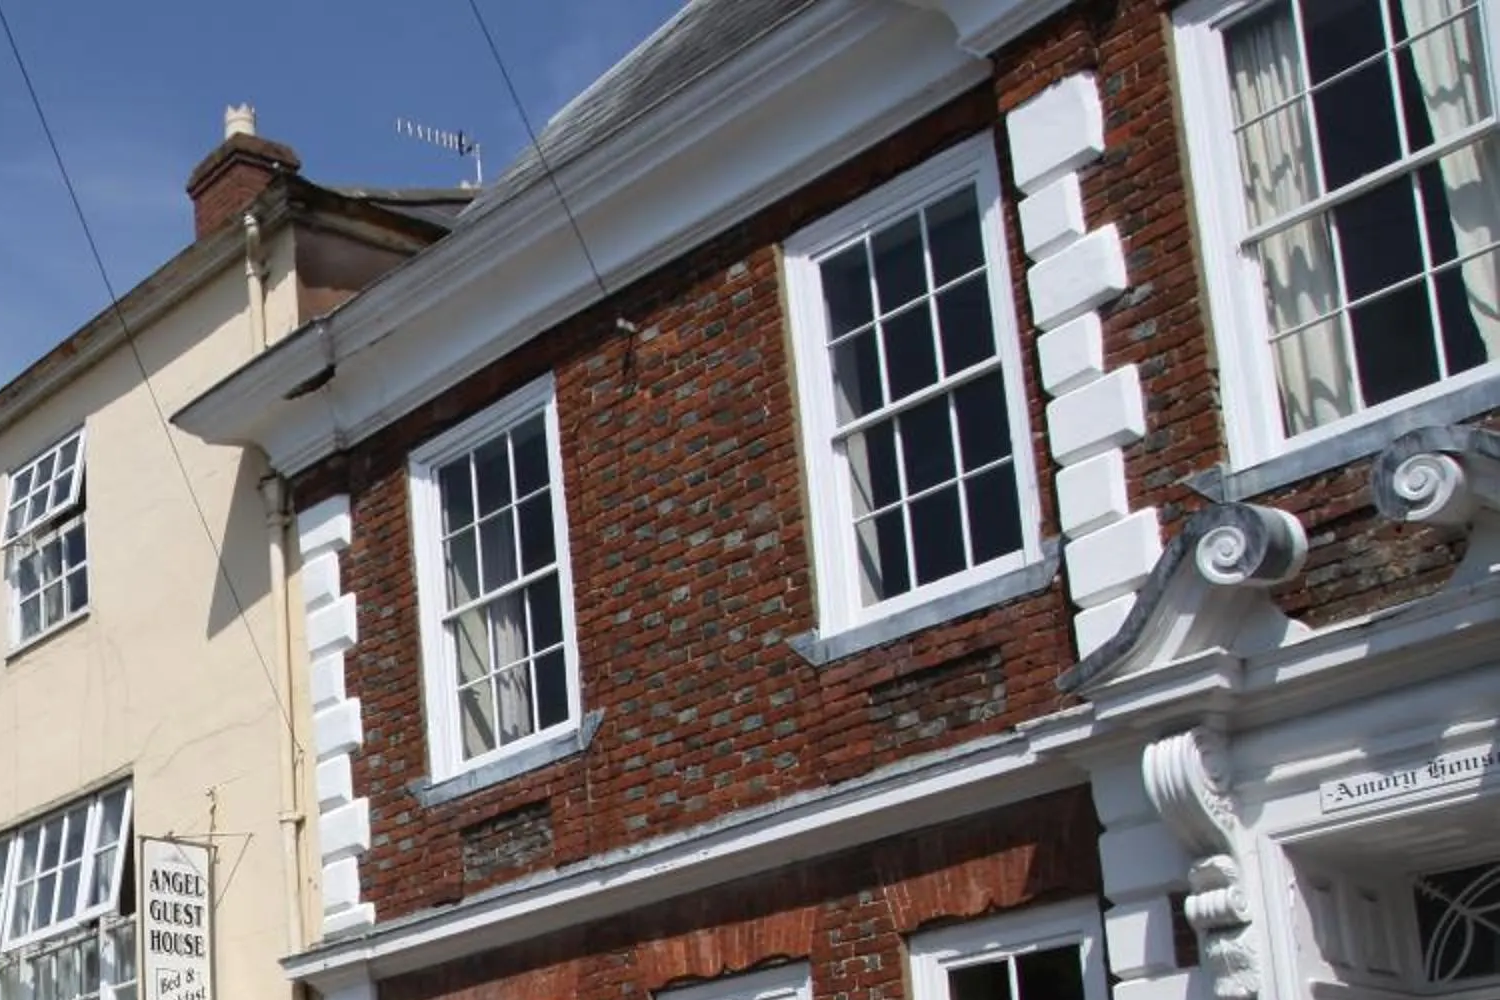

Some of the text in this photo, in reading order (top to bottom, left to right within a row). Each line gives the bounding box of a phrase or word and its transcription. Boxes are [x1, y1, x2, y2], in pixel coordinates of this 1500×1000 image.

[149, 868, 205, 898] ANGEL
[149, 899, 204, 928] GUEST
[150, 930, 205, 957] HOUSE
[160, 967, 195, 995] Bed &
